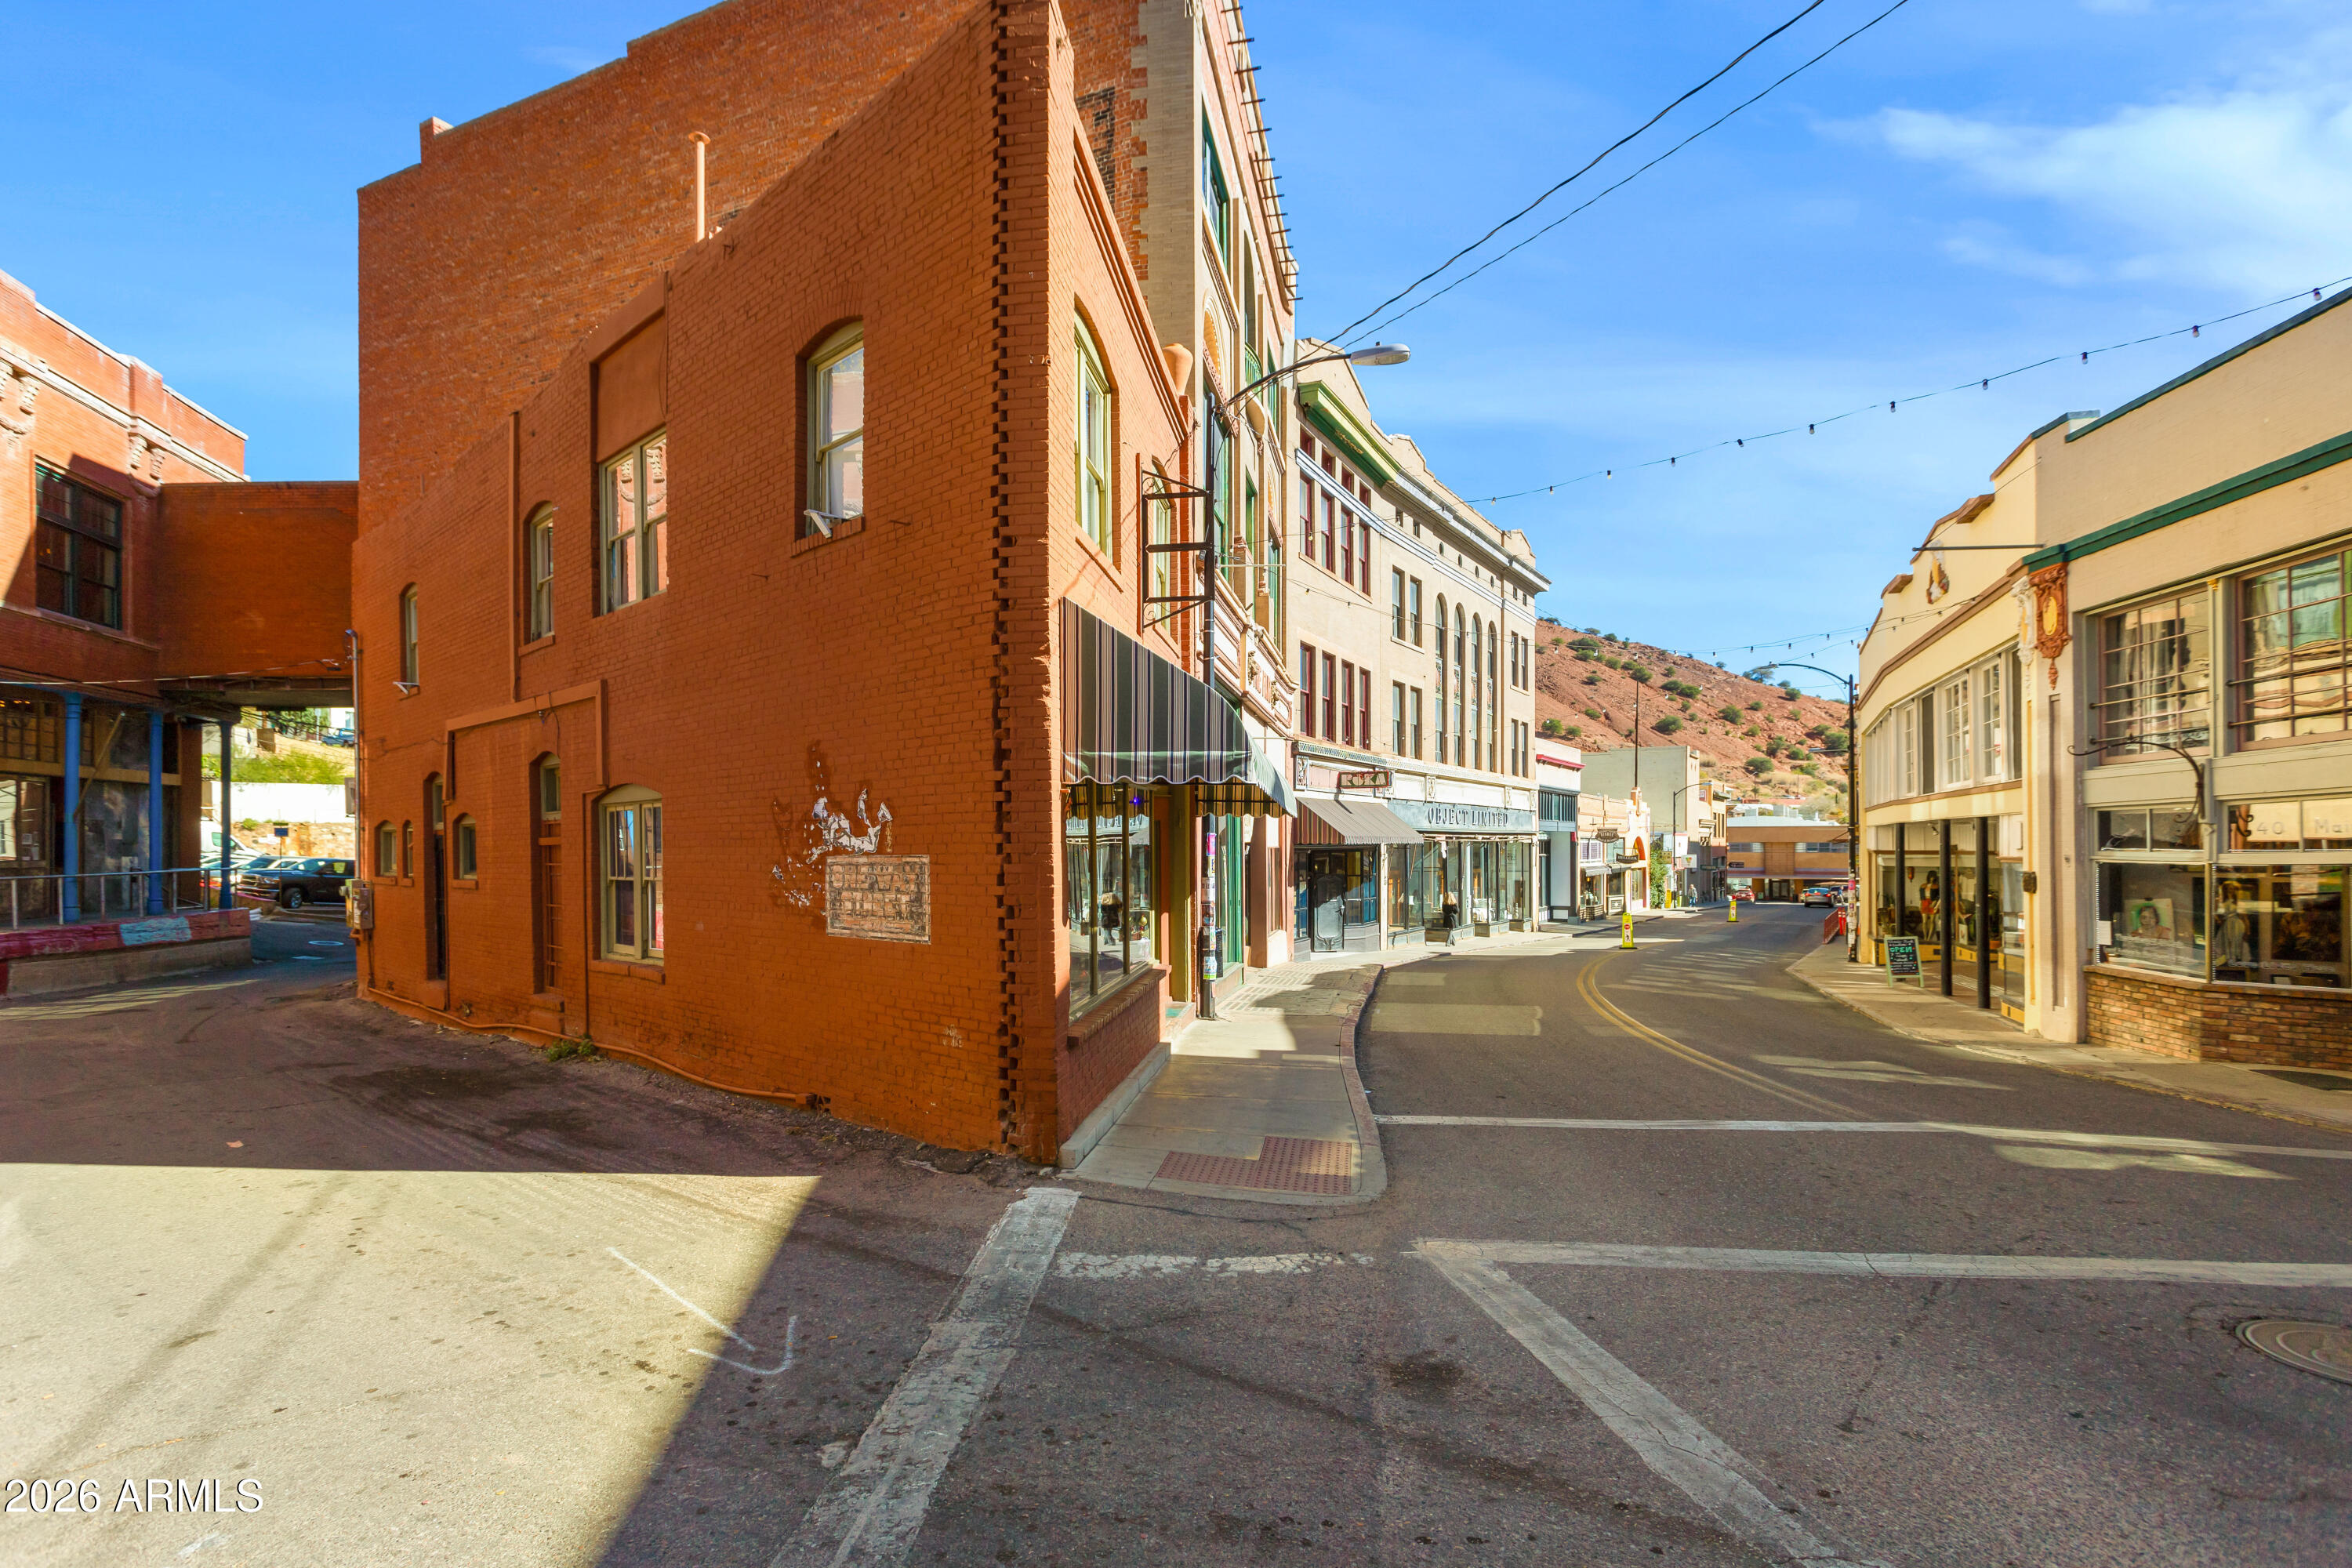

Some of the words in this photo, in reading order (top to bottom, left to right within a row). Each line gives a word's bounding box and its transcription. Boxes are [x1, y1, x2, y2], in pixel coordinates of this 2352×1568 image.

[1428, 807, 1468, 826] OBJECT
[1472, 810, 1509, 827] LIMITED
[2256, 821, 2285, 835] 40
